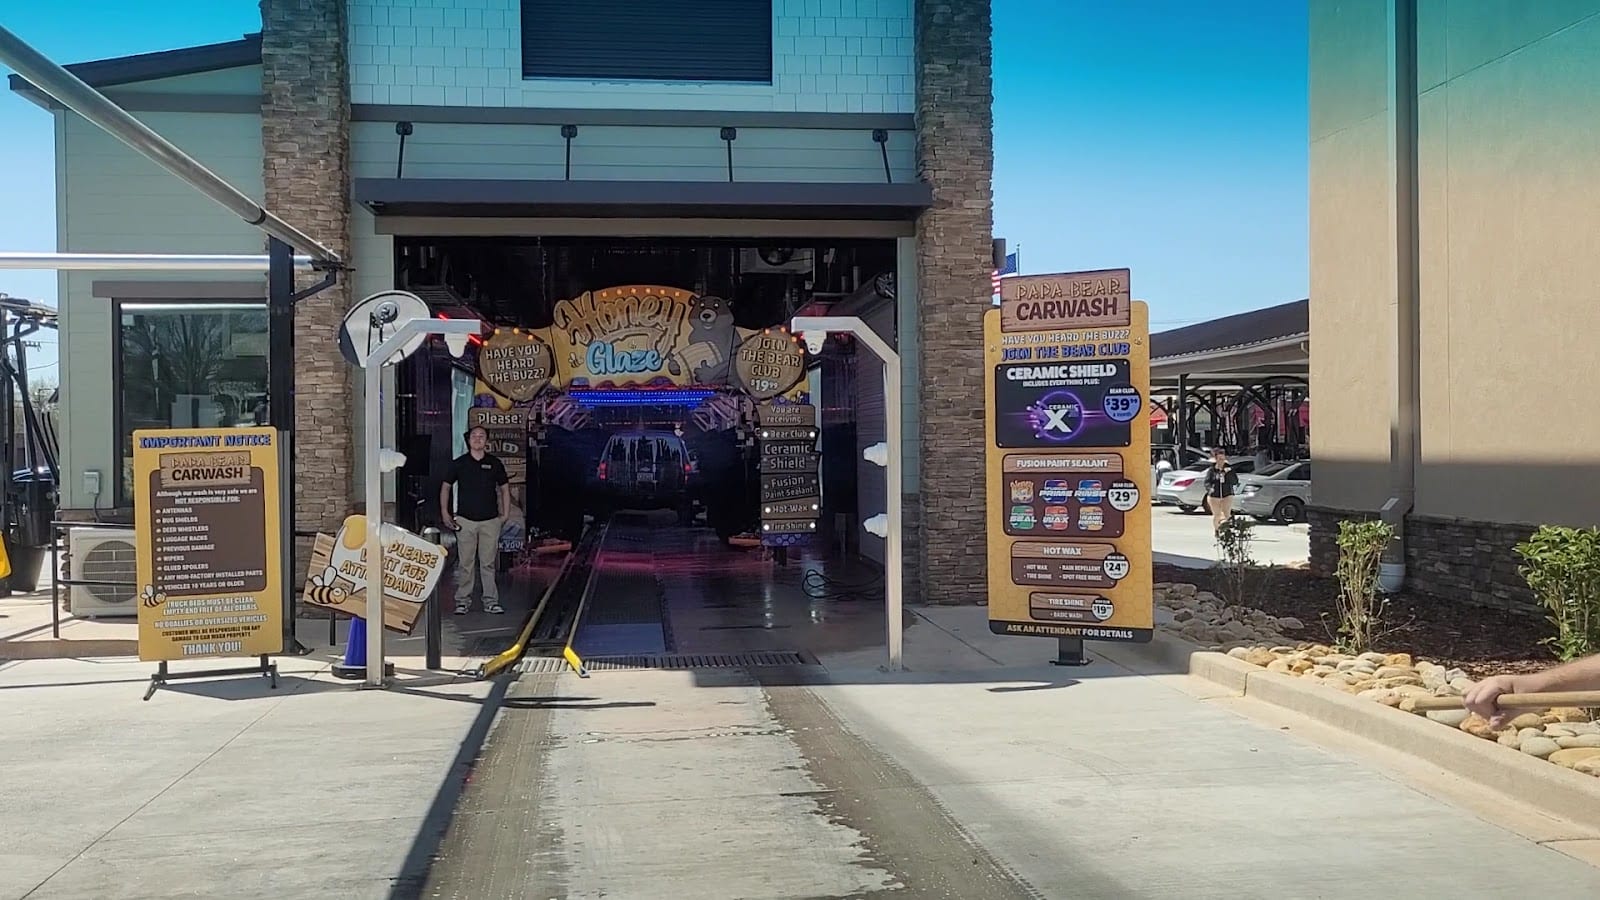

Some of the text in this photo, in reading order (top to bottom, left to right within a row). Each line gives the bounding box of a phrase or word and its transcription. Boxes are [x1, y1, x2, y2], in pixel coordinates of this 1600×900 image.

[1016, 278, 1121, 300] PAPA BEAR
[1016, 297, 1118, 321] CARWASH
[553, 290, 686, 359] Honey
[757, 337, 788, 351] JOIN
[1002, 329, 1130, 345] HAVE YOU HEARD THE BUZZ?
[485, 344, 540, 360] HAVE YOU
[586, 339, 662, 375] Glaze
[742, 349, 801, 368] THE BEAR
[1001, 342, 1130, 361] JOIN THE BEAR CLUB
[497, 357, 535, 370] HEARD
[488, 367, 545, 384] THE BUZZ?
[751, 364, 781, 378] CLUB
[1006, 363, 1117, 381] CERAMIC SHIELD
[1049, 379, 1083, 387] EVERYTHING
[770, 405, 800, 414] You are
[477, 412, 522, 425] Please:
[1043, 409, 1073, 432] X
[770, 429, 808, 438] Bear Club
[139, 433, 272, 449] IMPORTANT NOTICE
[764, 441, 811, 455] Ceramic
[210, 455, 248, 467] BEAR
[770, 456, 806, 469] Shield
[1016, 459, 1108, 468] FUSION PAINT SEALANT
[172, 467, 243, 481] CARWASH
[771, 475, 805, 488] Fusion
[156, 490, 182, 498] Although
[214, 489, 226, 497] very
[765, 486, 814, 499] Paint Sealant
[162, 535, 188, 543] LUGGAGE
[387, 540, 439, 568] PLEASE
[1043, 547, 1082, 556] HOT WAX
[339, 560, 425, 598] ATTDANT
[399, 562, 429, 582] FOR
[167, 600, 188, 608] TRUCK
[206, 598, 225, 606] MUST
[1048, 598, 1064, 606] TIRE
[163, 608, 185, 616] EMPTY
[185, 607, 198, 615] AND
[199, 606, 213, 614] FREE
[223, 604, 235, 612] ALL
[235, 603, 258, 612] DEBRIS
[194, 618, 203, 626] OR
[204, 616, 239, 626] OVERSIZED
[239, 614, 268, 623] VEHICLES
[209, 626, 240, 634] RESPONSIBLE
[1006, 624, 1133, 639] ASK AN ATTENDANT FOR DETAILS
[182, 641, 242, 656] THANK YOU!
